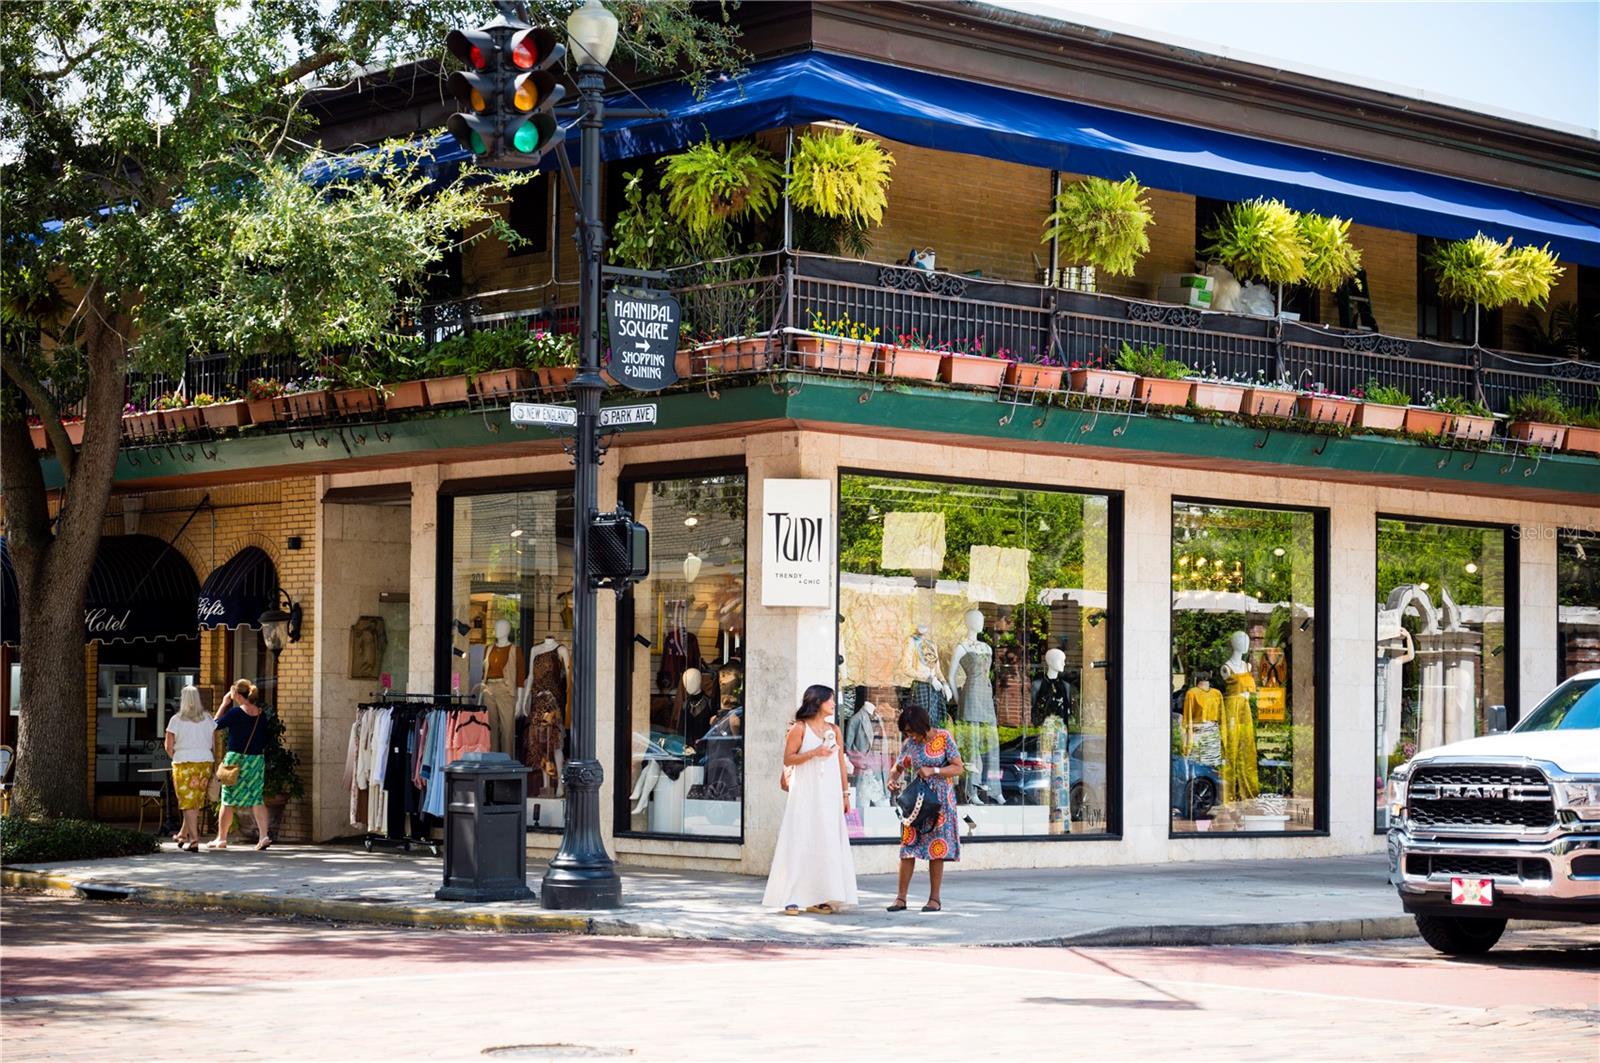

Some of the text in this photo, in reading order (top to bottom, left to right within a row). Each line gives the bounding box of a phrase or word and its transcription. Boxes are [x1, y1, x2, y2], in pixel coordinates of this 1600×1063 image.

[614, 300, 674, 323] HANNIBAL
[618, 319, 669, 340] SQUARE
[621, 351, 665, 367] SHOPPING
[526, 407, 541, 420] NEW
[543, 408, 568, 423] ENGLAND
[603, 407, 650, 424] S PARK AVE
[1442, 784, 1504, 799] RAM
